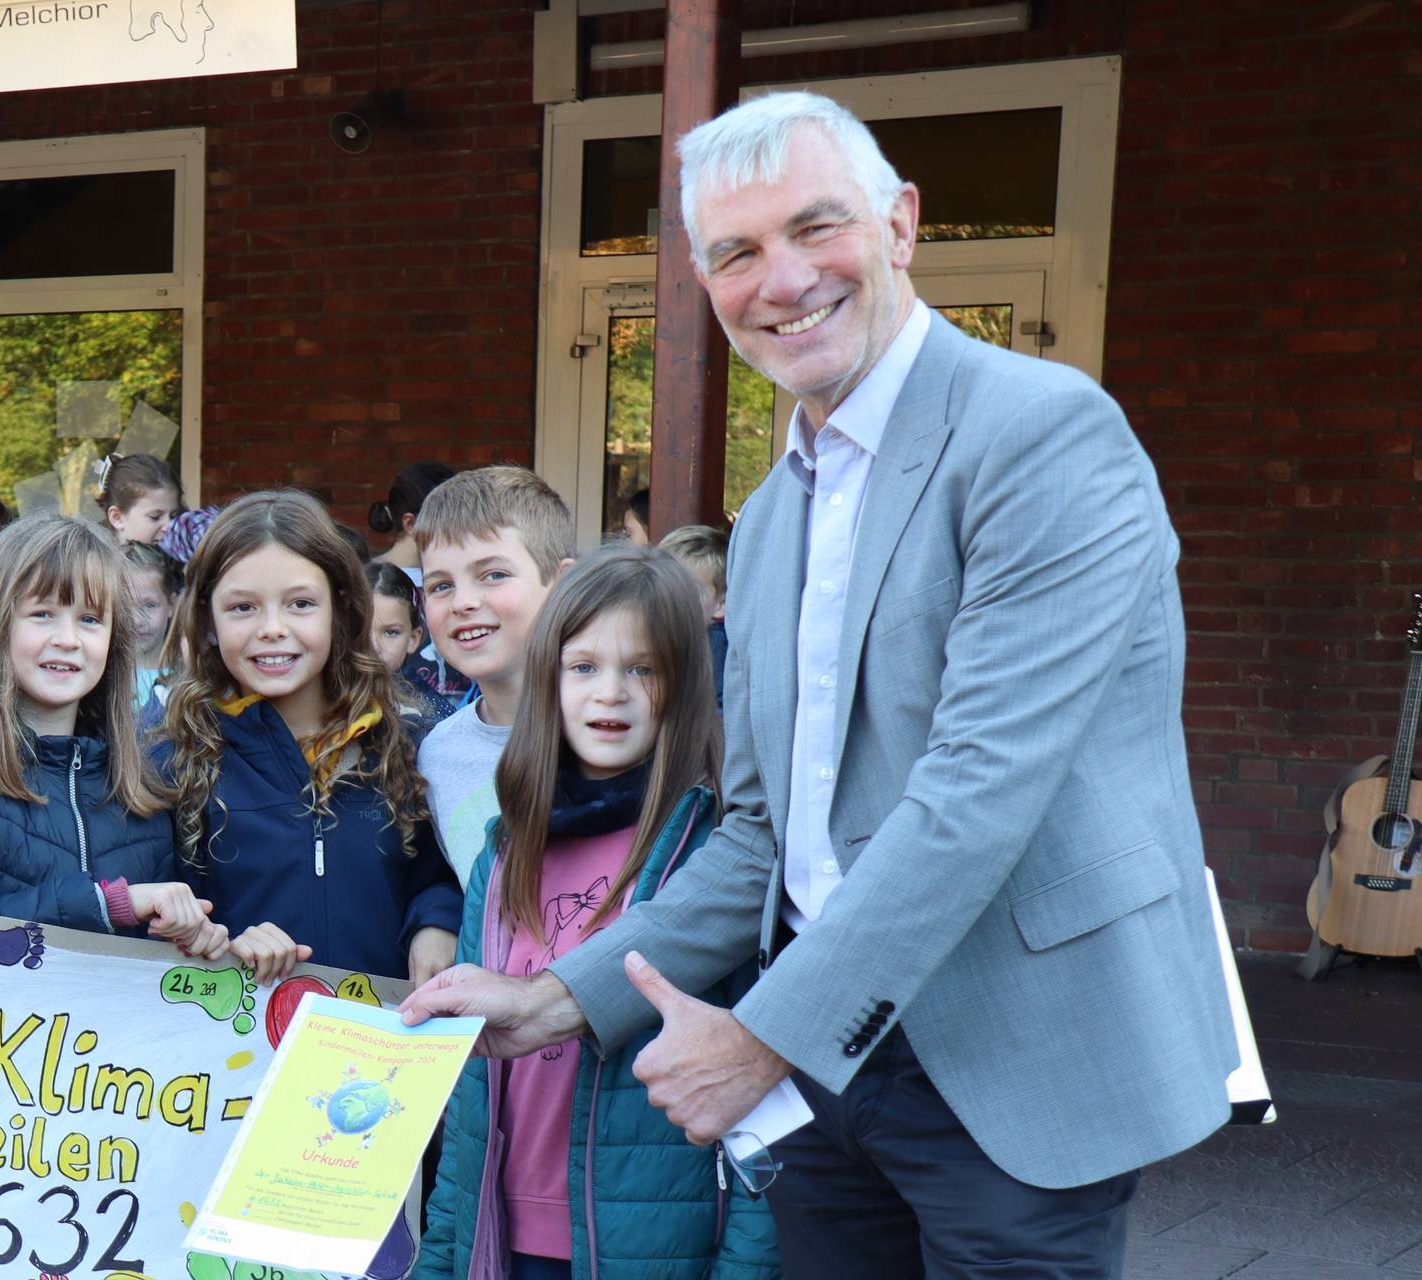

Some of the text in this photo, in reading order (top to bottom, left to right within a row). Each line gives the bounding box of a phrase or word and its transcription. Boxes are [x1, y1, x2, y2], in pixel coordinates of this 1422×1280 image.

[169, 973, 194, 994] 2b
[346, 981, 363, 998] 1b
[302, 1148, 360, 1169] Urkunde
